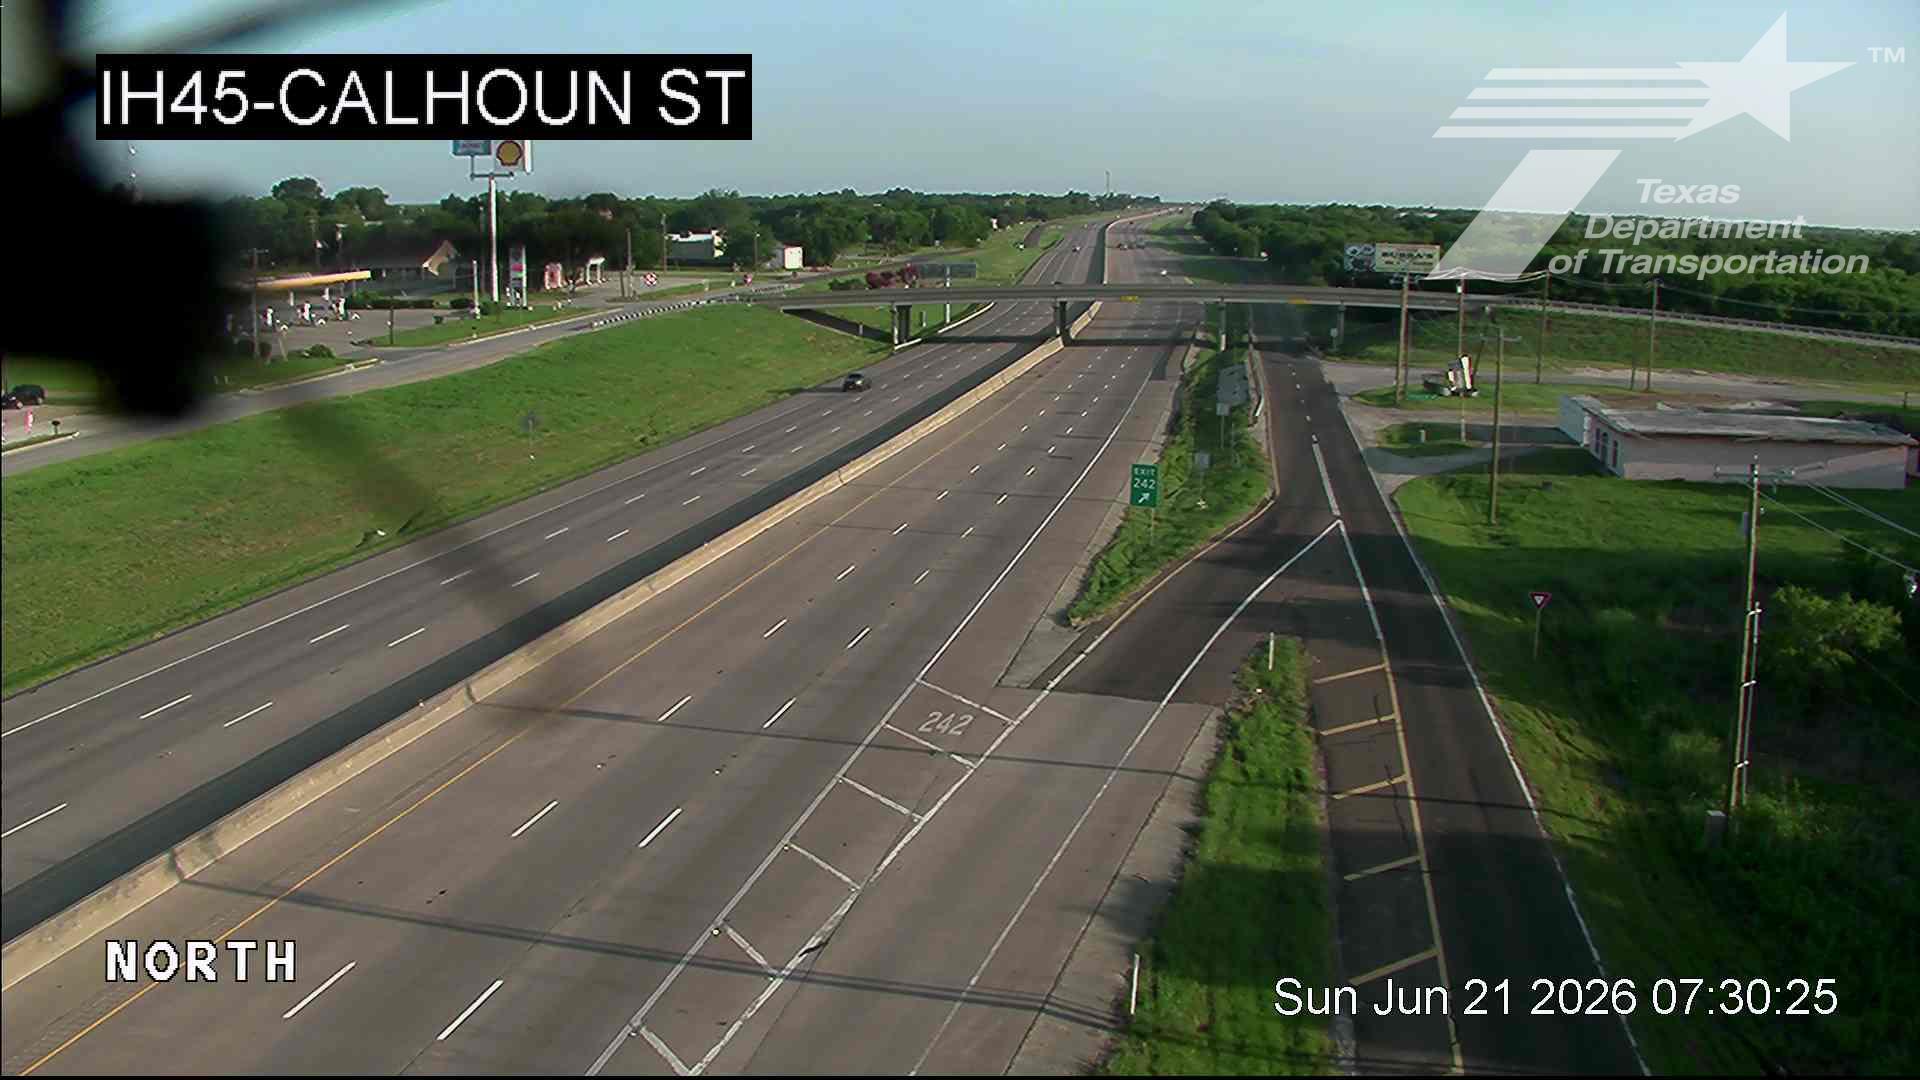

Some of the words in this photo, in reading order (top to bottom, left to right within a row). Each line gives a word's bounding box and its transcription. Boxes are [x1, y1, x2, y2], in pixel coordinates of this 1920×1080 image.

[1134, 467, 1156, 476] EXIT
[1133, 478, 1156, 489] 242
[918, 711, 974, 735] 242
